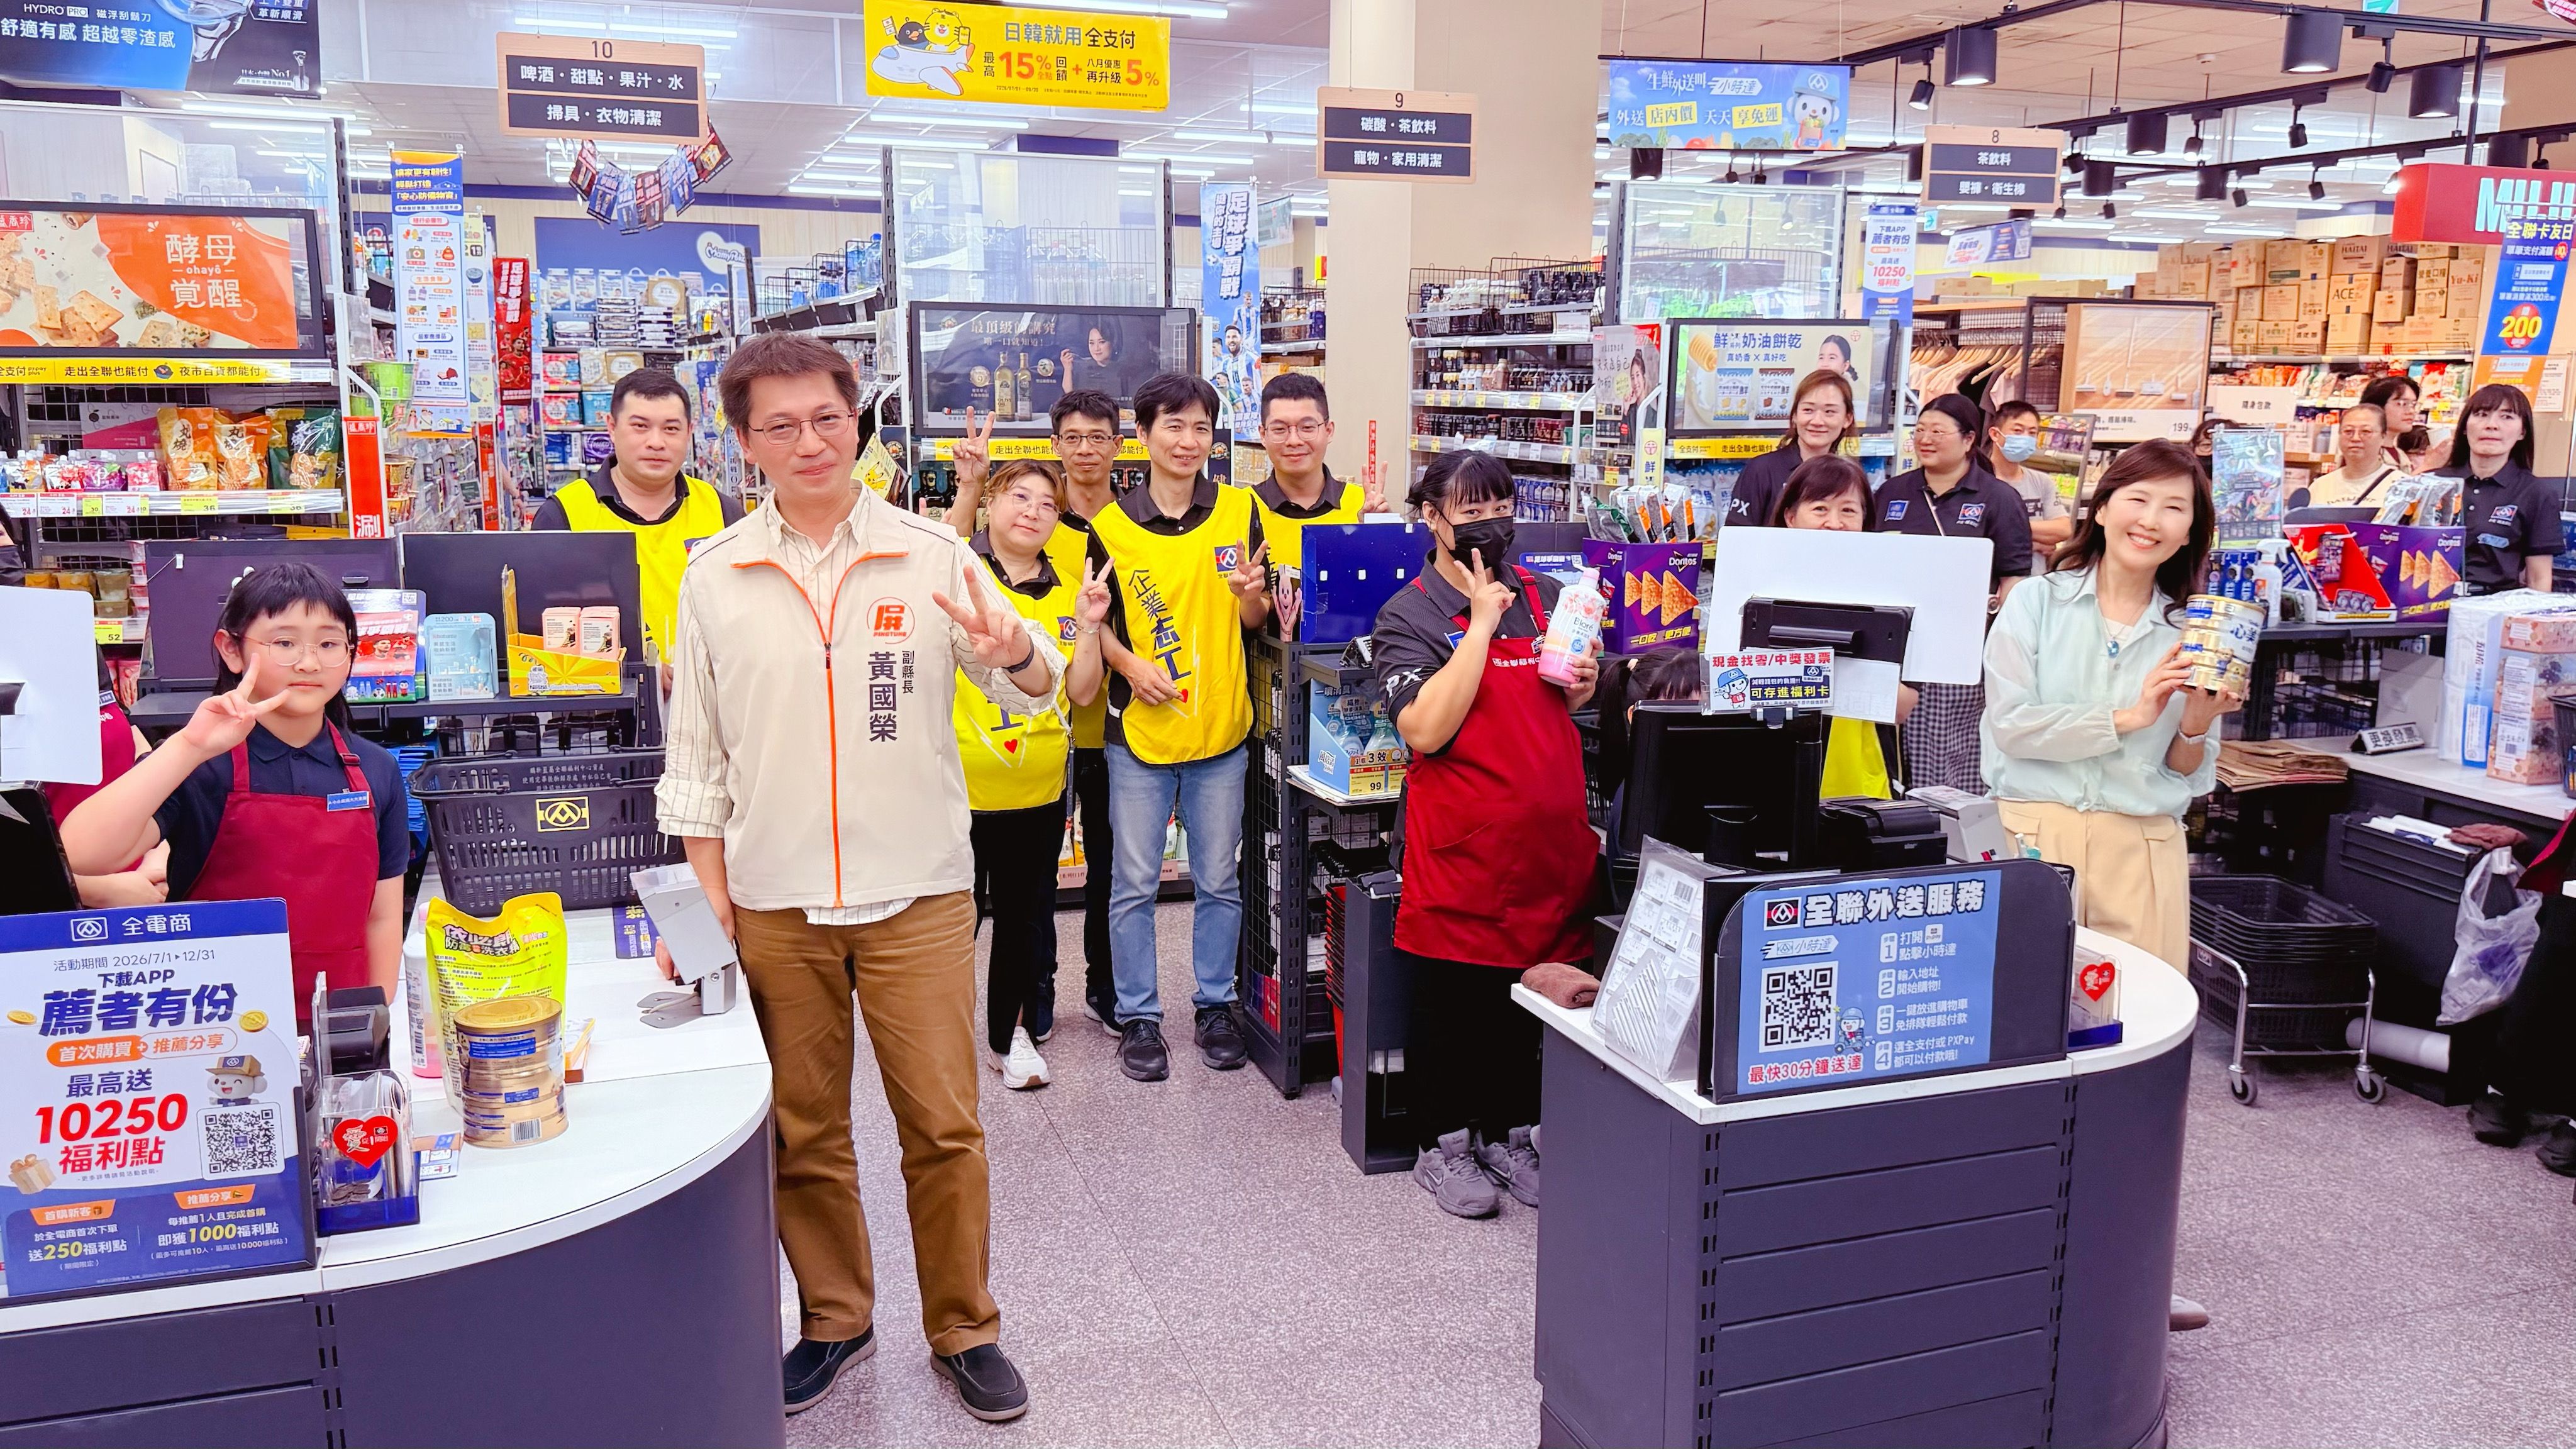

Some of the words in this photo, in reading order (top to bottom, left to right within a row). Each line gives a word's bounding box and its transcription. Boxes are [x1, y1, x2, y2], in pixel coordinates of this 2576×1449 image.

[24, 3, 64, 16] HYDRO
[68, 8, 87, 17] PRO
[96, 9, 151, 22] 磁浮刮鬍刀
[258, 8, 303, 20] 革新順滑
[1, 18, 77, 41] 舒適有感
[82, 24, 175, 48] 超越零渣感
[1005, 22, 1082, 47] 日韓就用
[1085, 27, 1136, 49] 全支付
[592, 40, 613, 59] 10
[984, 52, 995, 77] 最高
[999, 51, 1052, 79] 15%
[1056, 57, 1067, 82] 回饋
[1087, 58, 1121, 69] 八月優惠
[1126, 59, 1159, 86] 5%
[1087, 70, 1121, 84] 再升級
[1646, 70, 1706, 97] 生鮮外送叫
[1719, 80, 1757, 94] 小時達
[1396, 93, 1403, 108] 9
[1616, 109, 1645, 126] 外送
[1650, 104, 1693, 124] 店內價
[1704, 109, 1731, 125] 天天
[1738, 107, 1779, 125] 享免運
[1992, 130, 1999, 143] 8
[1977, 152, 2011, 166] 茶飲料
[2506, 221, 2573, 240] 全聯卡友日
[165, 233, 236, 265] 酵母
[705, 243, 747, 263] MamyPok
[1219, 191, 1250, 300] 足球爭霸戰
[1873, 266, 1906, 277] 10250
[2332, 288, 2355, 300] ACE
[2498, 315, 2543, 338] 200
[1741, 332, 1802, 349] 奶油餅乾
[1727, 353, 1750, 362] 真奶香
[1763, 353, 1787, 363] 真好吃
[64, 365, 150, 378] 走出全聯也能付
[179, 365, 262, 378] 夜市百貨都能付
[2172, 422, 2189, 432] 199
[995, 445, 1055, 455] 走出全聯也能
[355, 514, 380, 538] 涮
[1668, 556, 1697, 566] Doritos
[874, 604, 906, 631] 屏
[1129, 569, 1192, 681] 企業志工
[1574, 617, 1594, 631] Bioré
[108, 633, 121, 641] 52
[1713, 652, 1831, 667] 現金找零/中獎發票
[902, 650, 914, 694] 副縣長
[868, 651, 898, 742] 黃國榮
[1750, 685, 1829, 698] 可存進福利卡
[1370, 782, 1382, 791] 99
[1803, 880, 1985, 929] 全聯外送服務
[122, 913, 192, 936] 全電商
[1794, 937, 1833, 954] 小時達
[1900, 931, 1922, 945] 打開
[53, 957, 108, 972] 活動期間
[113, 952, 172, 968] 2026/7/1
[182, 949, 215, 962] 12/31
[1899, 943, 1957, 961] 點擊小時達
[97, 969, 175, 989] 下載APP
[1897, 967, 1940, 982] 輸入地址
[1880, 980, 1892, 996] 2
[38, 982, 238, 1038] 薦者有份
[1896, 999, 1968, 1016] 一鍵放進購物車
[1879, 1016, 1891, 1031] 3
[1895, 1013, 1967, 1032] 免排隊輕鬆付款
[60, 1041, 131, 1063] 首次購買
[153, 1033, 224, 1053] 推薦分享
[1894, 1036, 1947, 1054] 選全支付或
[1948, 1035, 1975, 1046] PXPay
[1748, 1053, 1863, 1084] 最快30分鐘送達
[1876, 1052, 1890, 1067] 4
[65, 1068, 152, 1098] 最高送
[35, 1093, 189, 1144] 10250
[342, 1124, 370, 1153] 愛
[58, 1136, 166, 1175] 福利點
[187, 1192, 232, 1205] 推薦分享
[44, 1207, 91, 1221] 首購新客
[168, 1208, 266, 1227] 每推薦1人且完成首購
[34, 1224, 118, 1243] 於全電商首次下單
[158, 1221, 279, 1247] 即獲1000福利點
[28, 1238, 127, 1263] 送250福利點
